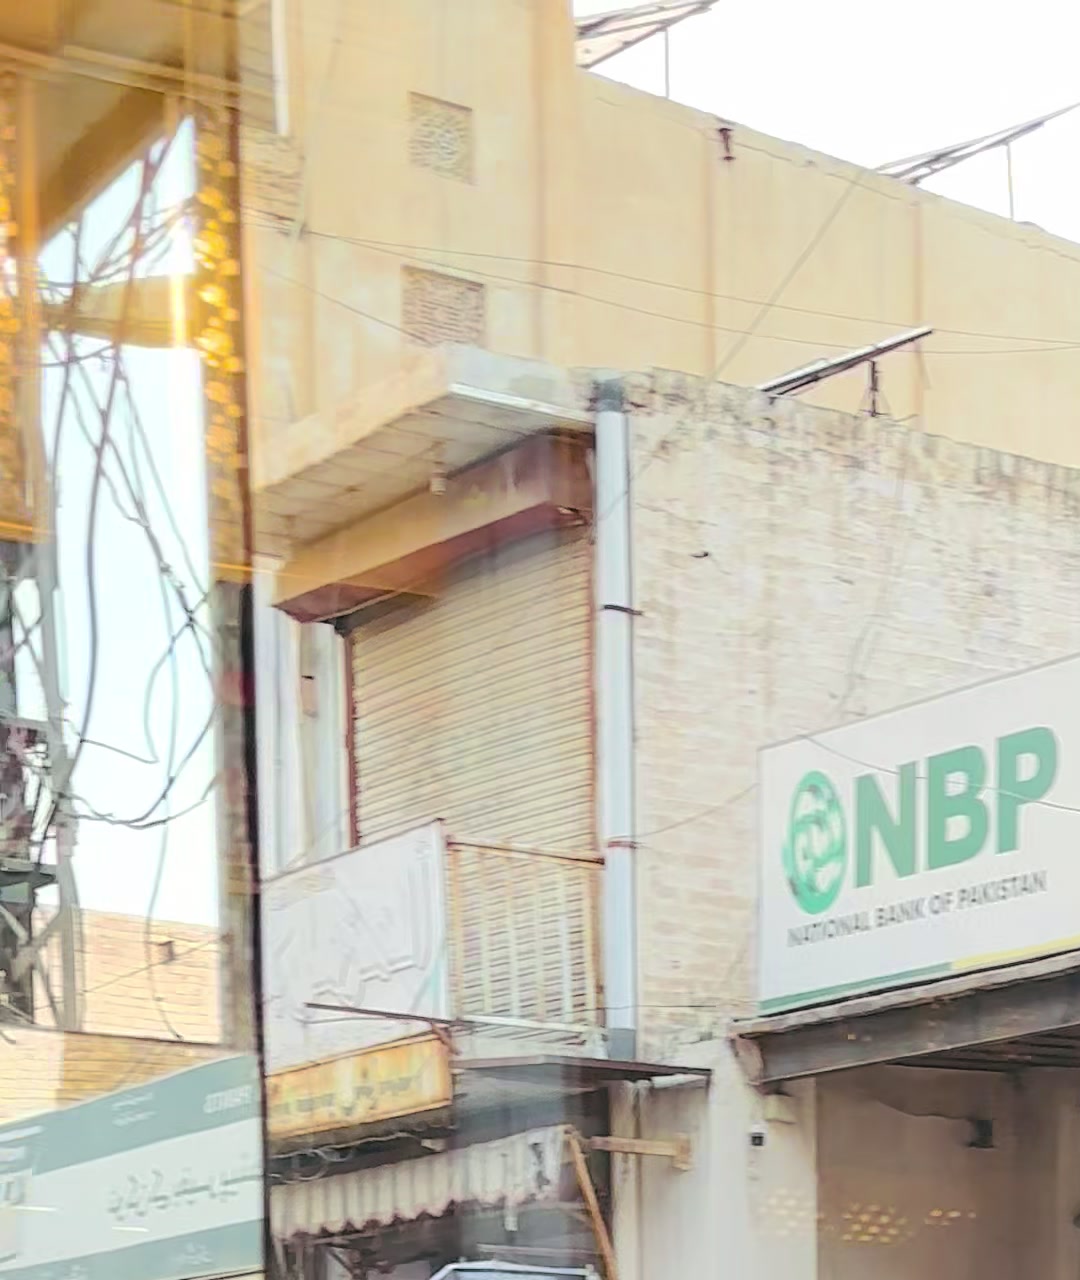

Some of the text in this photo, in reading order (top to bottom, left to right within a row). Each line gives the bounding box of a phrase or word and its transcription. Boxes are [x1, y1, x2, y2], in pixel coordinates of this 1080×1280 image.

[852, 727, 1059, 889] NBP
[787, 869, 1048, 948] NATIONAL BANK OF PAKISTAN
